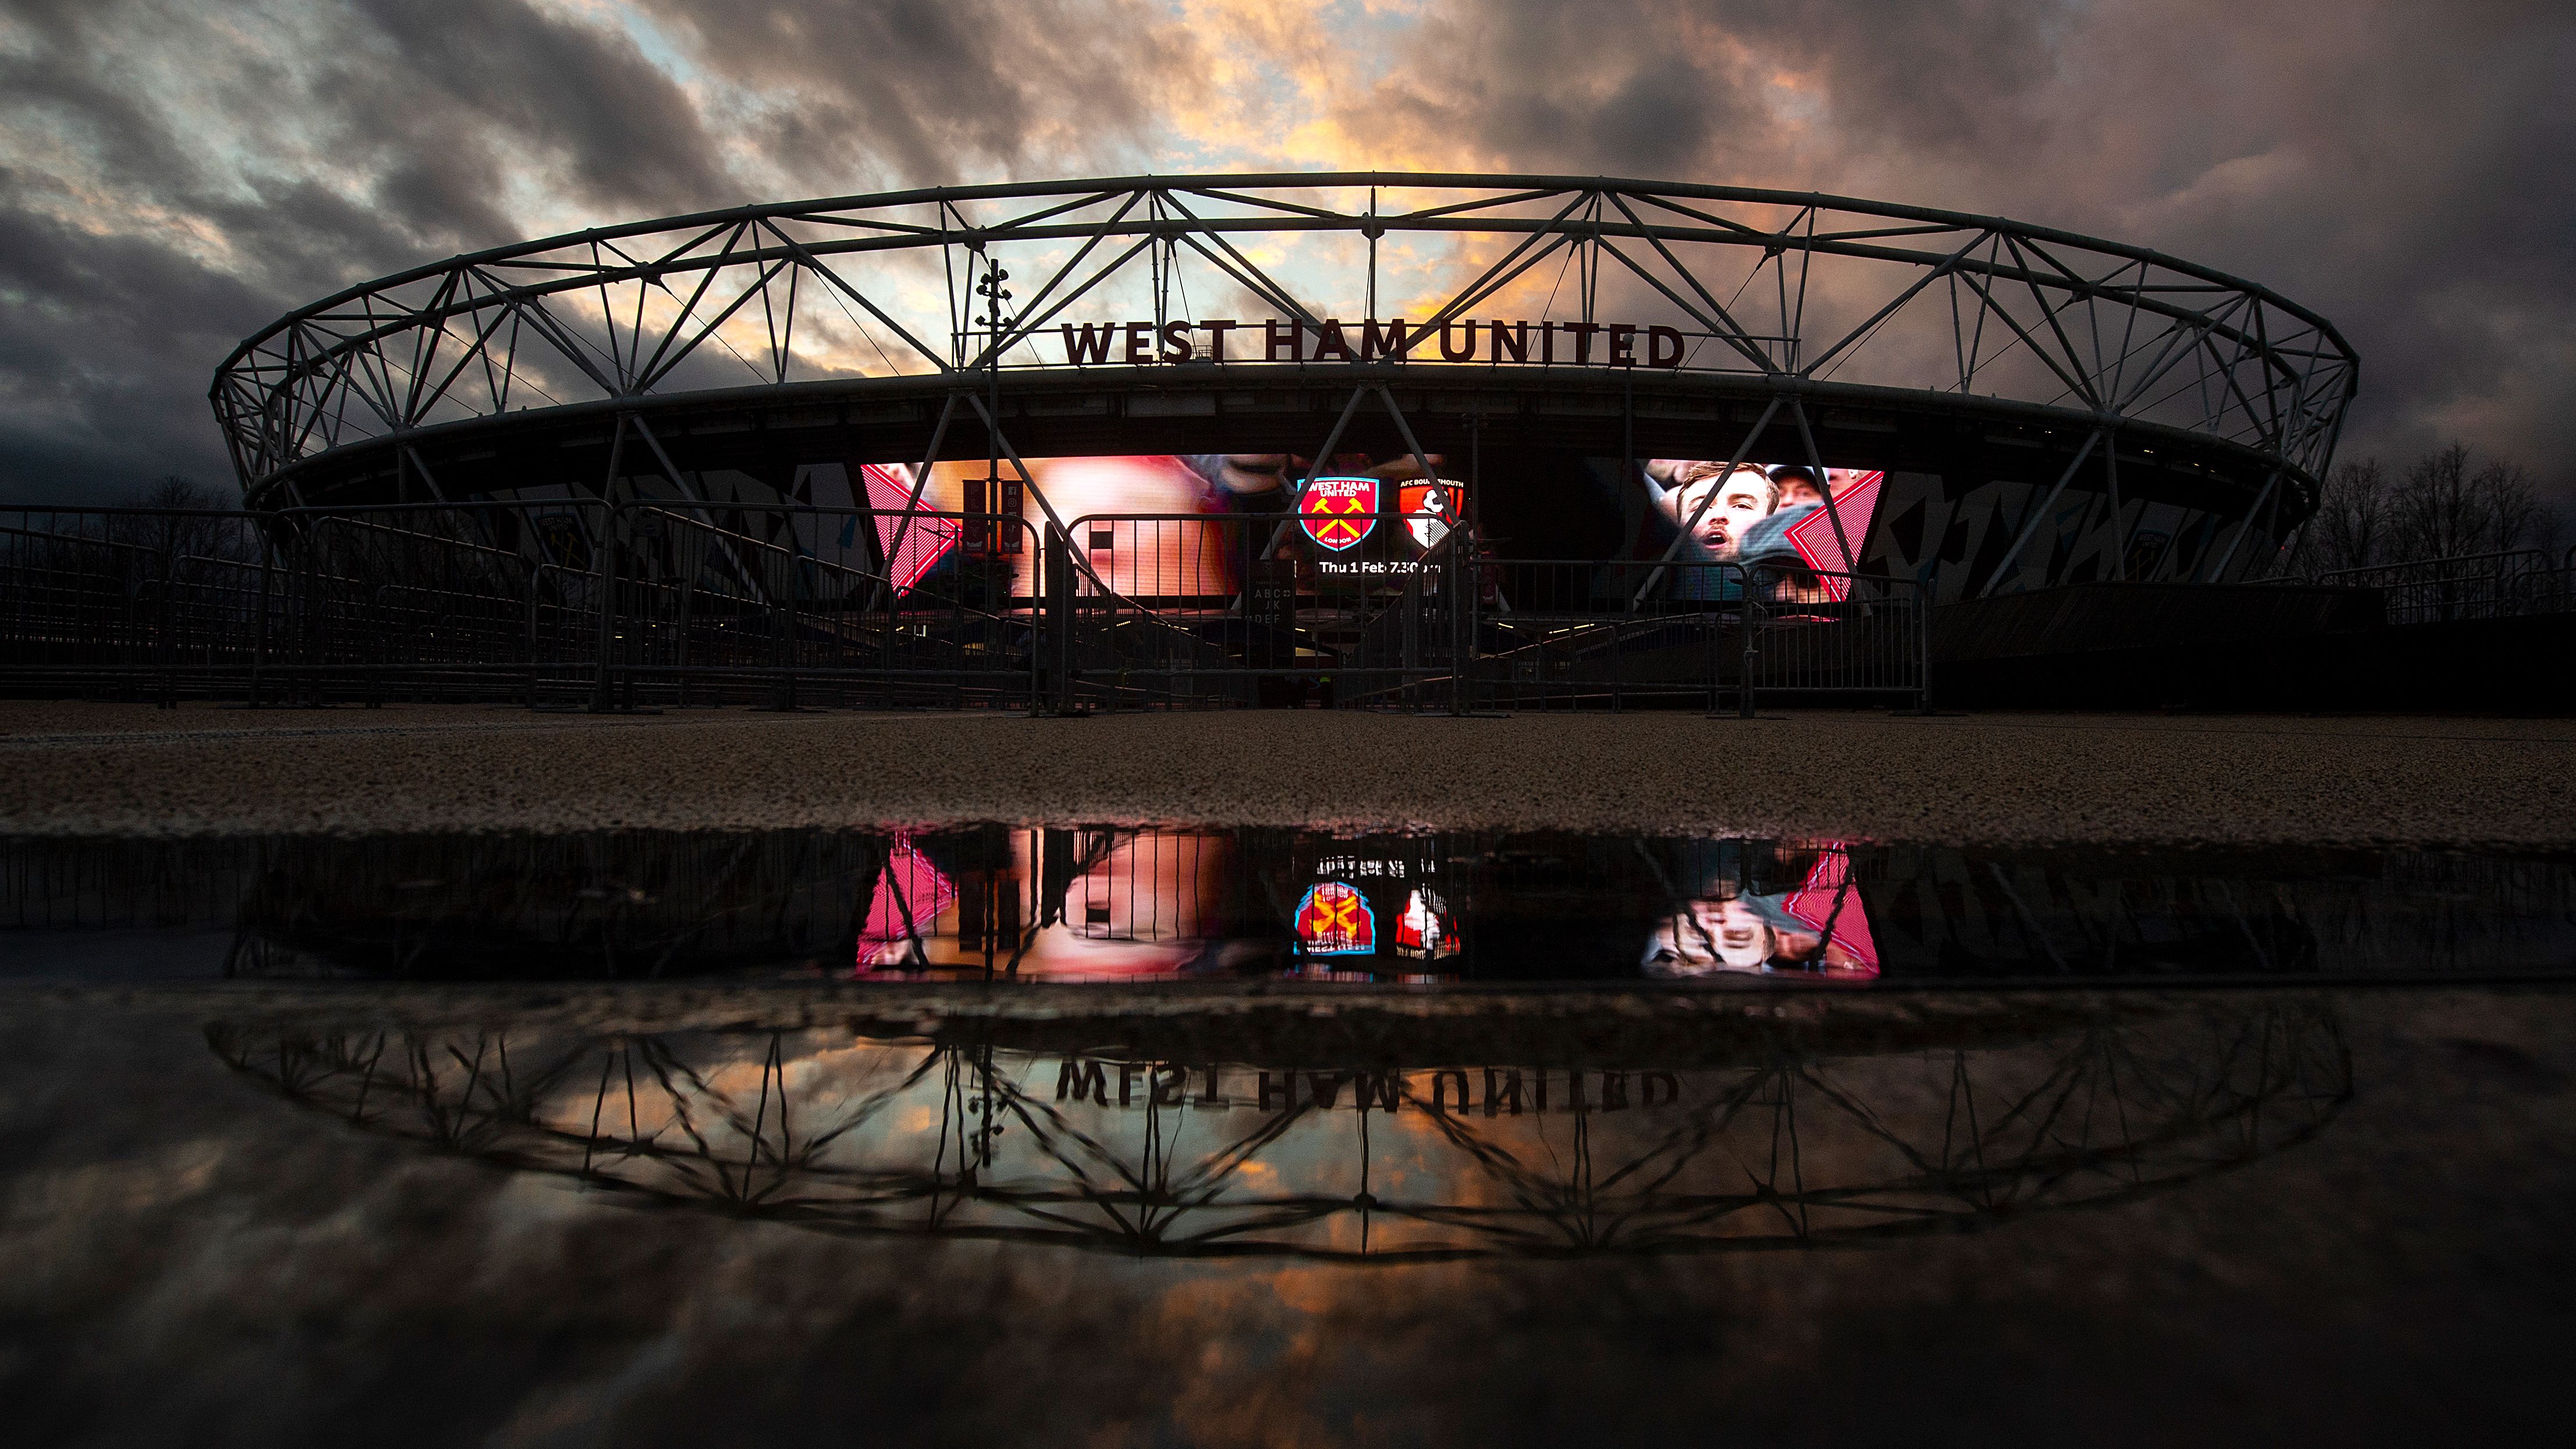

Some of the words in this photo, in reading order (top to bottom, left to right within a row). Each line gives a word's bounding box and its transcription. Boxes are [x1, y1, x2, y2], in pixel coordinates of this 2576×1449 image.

[1060, 321, 1236, 364] WEST
[1266, 319, 1407, 362] HAM
[1440, 319, 1684, 368] UNITED
[1308, 482, 1340, 492] WEST
[1341, 482, 1370, 492] HAM
[1400, 480, 1413, 488] AFC
[1414, 478, 1464, 488] BOUMOUTH
[1319, 562, 1347, 573] Thu
[1350, 562, 1358, 573] 1
[1362, 562, 1386, 573] Feb
